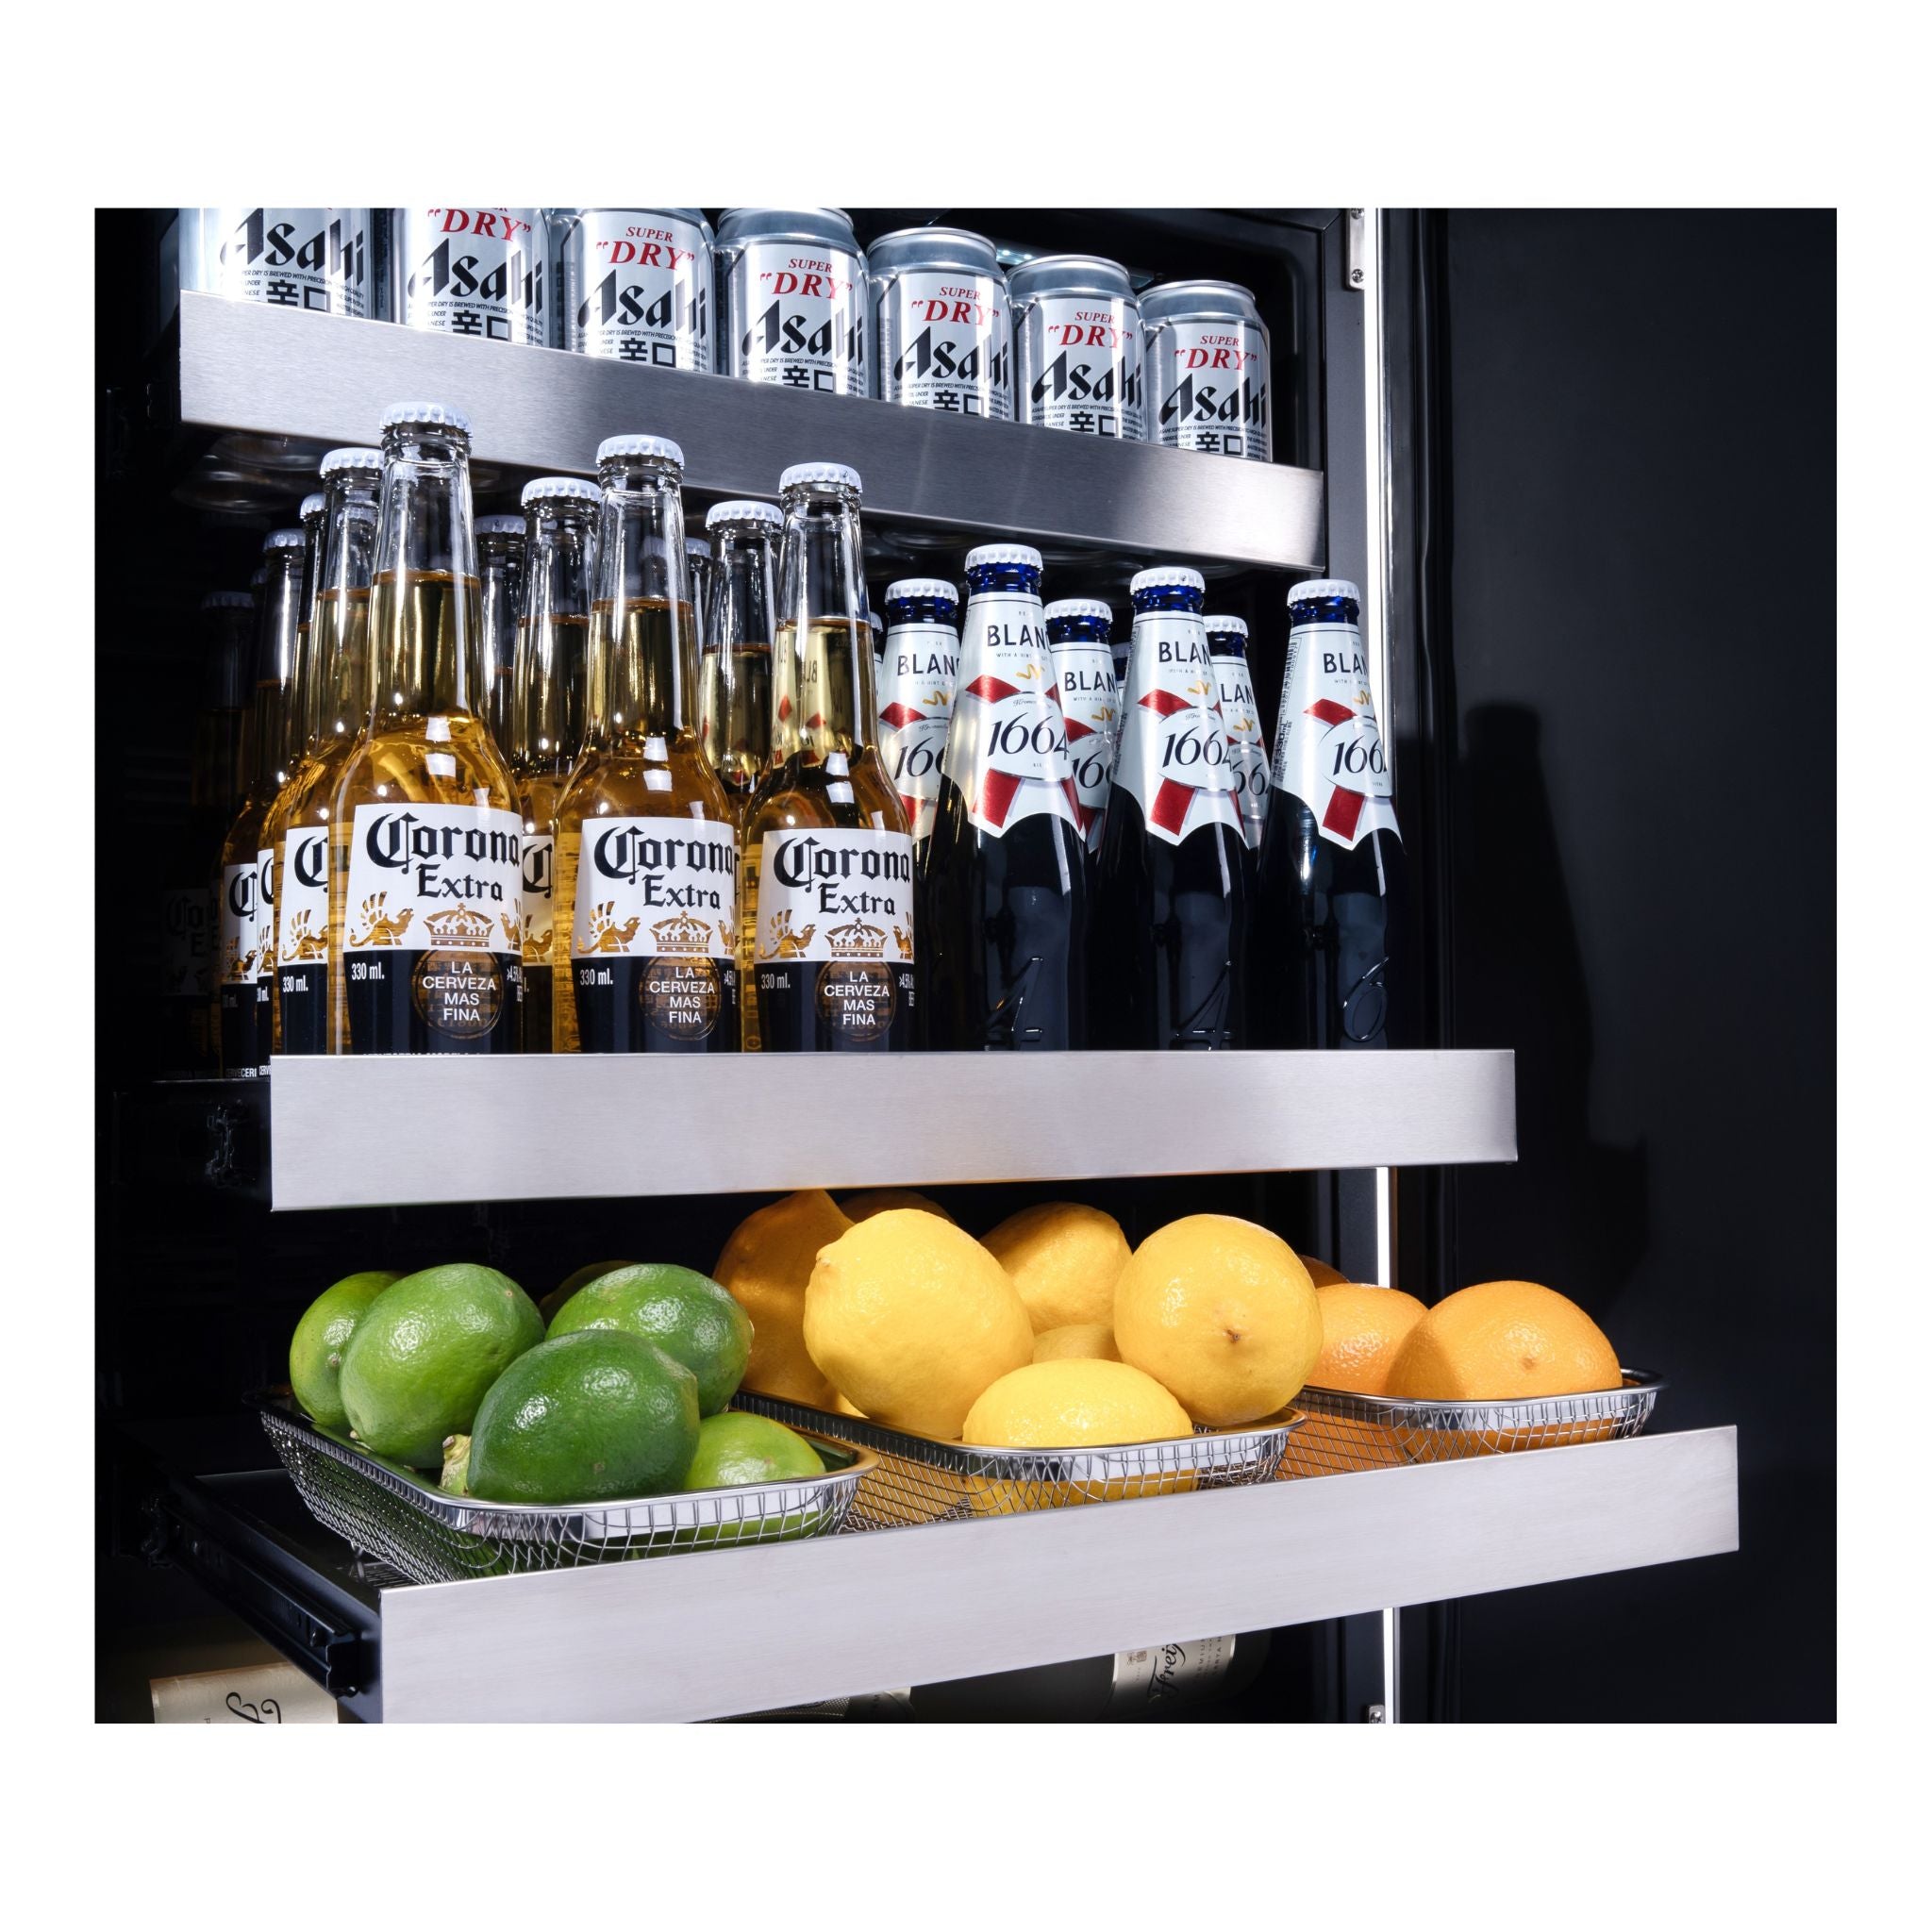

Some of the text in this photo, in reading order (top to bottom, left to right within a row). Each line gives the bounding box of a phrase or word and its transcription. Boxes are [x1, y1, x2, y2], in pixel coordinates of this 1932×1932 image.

[625, 226, 674, 242] SUPER
[220, 208, 363, 286] Asahi
[292, 273, 307, 281] WITH
[408, 238, 542, 314] Asahi
[788, 258, 833, 273] SUPER
[577, 269, 706, 340] Asahi
[939, 287, 980, 300] SUPER
[451, 309, 511, 341] 辛口
[1074, 311, 1115, 324] SUPER
[741, 299, 863, 366] Asahi
[1200, 335, 1240, 346] SUPER
[619, 338, 676, 368] 辛口
[894, 325, 1008, 391] Asahi
[782, 365, 836, 393] 辛口
[1031, 350, 1141, 409] Asahi
[933, 390, 984, 416] 辛口
[1158, 373, 1266, 429] Asahi
[1069, 411, 1119, 437] 辛口
[1195, 431, 1244, 457] 辛口
[897, 653, 959, 676] BLAN
[1221, 683, 1254, 706] LAN
[988, 711, 1070, 761] 1664
[894, 737, 945, 780] 16
[1072, 751, 1113, 789] 16
[366, 811, 521, 875] Corona
[594, 825, 734, 886] Corona
[773, 836, 911, 893] Corona
[415, 862, 504, 902] Extra
[641, 874, 721, 909] Extra
[818, 882, 896, 916] Extra
[351, 961, 385, 981] 330 ml.
[451, 960, 474, 974] LA
[579, 968, 614, 986] 330 ml.
[675, 966, 695, 979] LA
[849, 971, 869, 983] LA
[282, 975, 294, 992] 330
[422, 976, 497, 991] CERVEZA
[649, 981, 715, 994] CERVEZA
[760, 972, 791, 990] 330 ml.
[824, 985, 890, 997] CERVEZA
[444, 992, 480, 1007] MAS
[669, 996, 701, 1008] MAS
[843, 999, 875, 1011] MAS
[443, 1008, 480, 1022] FINA
[669, 1011, 702, 1024] FINA
[842, 1013, 876, 1025] FINA
